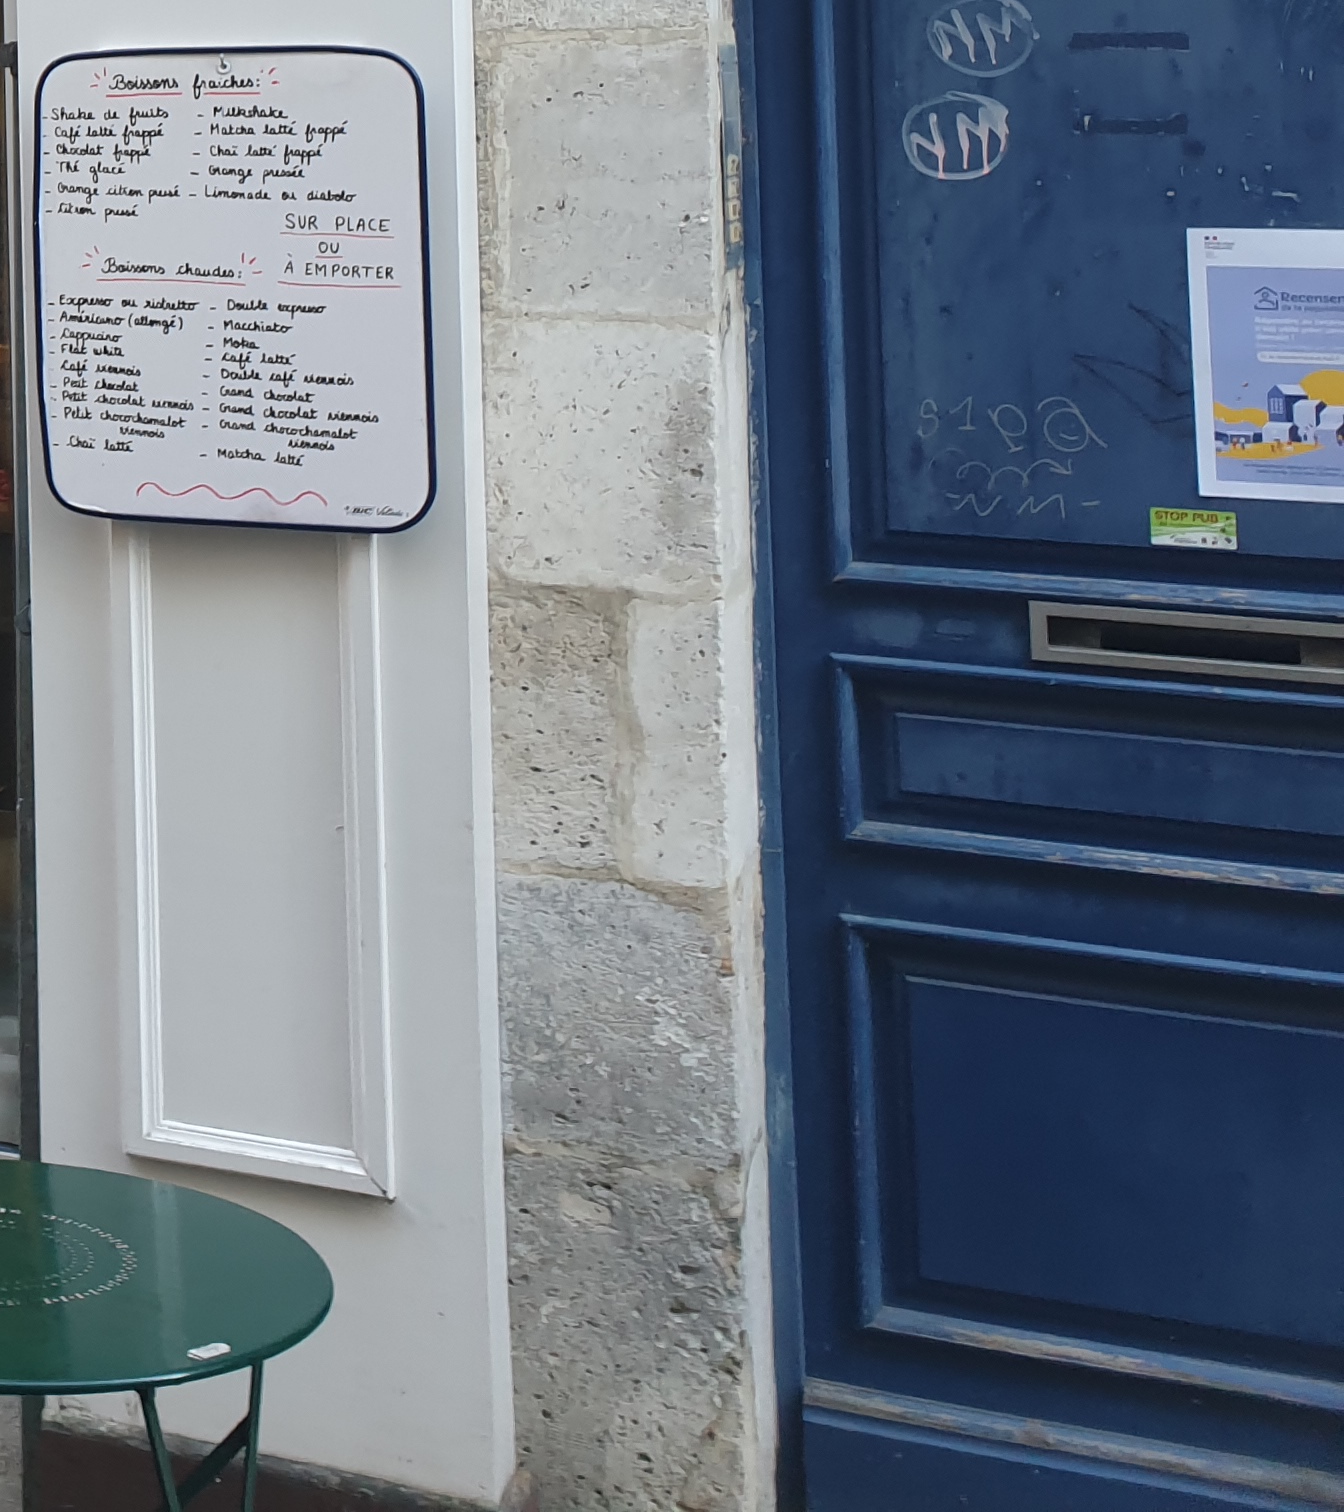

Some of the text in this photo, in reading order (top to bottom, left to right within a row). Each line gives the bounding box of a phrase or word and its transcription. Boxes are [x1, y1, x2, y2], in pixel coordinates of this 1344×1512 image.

[109, 74, 178, 90] Boissons
[51, 107, 169, 126] Shake de fruits
[213, 106, 289, 118] Milkshake
[54, 123, 164, 146] Café frappé
[210, 120, 348, 143] Matcha latté frappé
[56, 143, 151, 164] Chocolat frappé
[284, 143, 323, 165] frappé
[56, 160, 126, 183] Thé glacé
[209, 164, 305, 184] Orange pressée
[57, 182, 99, 204] Orange
[106, 185, 144, 196] citron
[204, 184, 357, 202] Limonade ou diabolo
[284, 213, 391, 232] SUR PLACE
[317, 241, 340, 255] OU
[101, 257, 166, 275] Boissons
[304, 262, 395, 280] EMPORTER
[60, 294, 113, 313] Expresso
[121, 298, 137, 308] ou
[227, 299, 327, 319] Double expresso
[59, 311, 125, 325] Américano
[223, 320, 293, 333] Macchiato
[61, 344, 125, 357] Flat white
[223, 337, 260, 349] Moka
[61, 359, 88, 377] Café
[221, 352, 296, 369] Café latté
[220, 368, 354, 388] Double café viennois
[95, 394, 146, 407] chocolat
[219, 386, 315, 403] Grand chocolat
[64, 406, 92, 419] Petit
[219, 402, 254, 416] Grand
[263, 406, 318, 420] chocolat
[219, 419, 256, 430] Grand
[104, 439, 134, 453] latté
[217, 448, 305, 467] Matcha latté
[1155, 510, 1218, 523] STOP PUB
